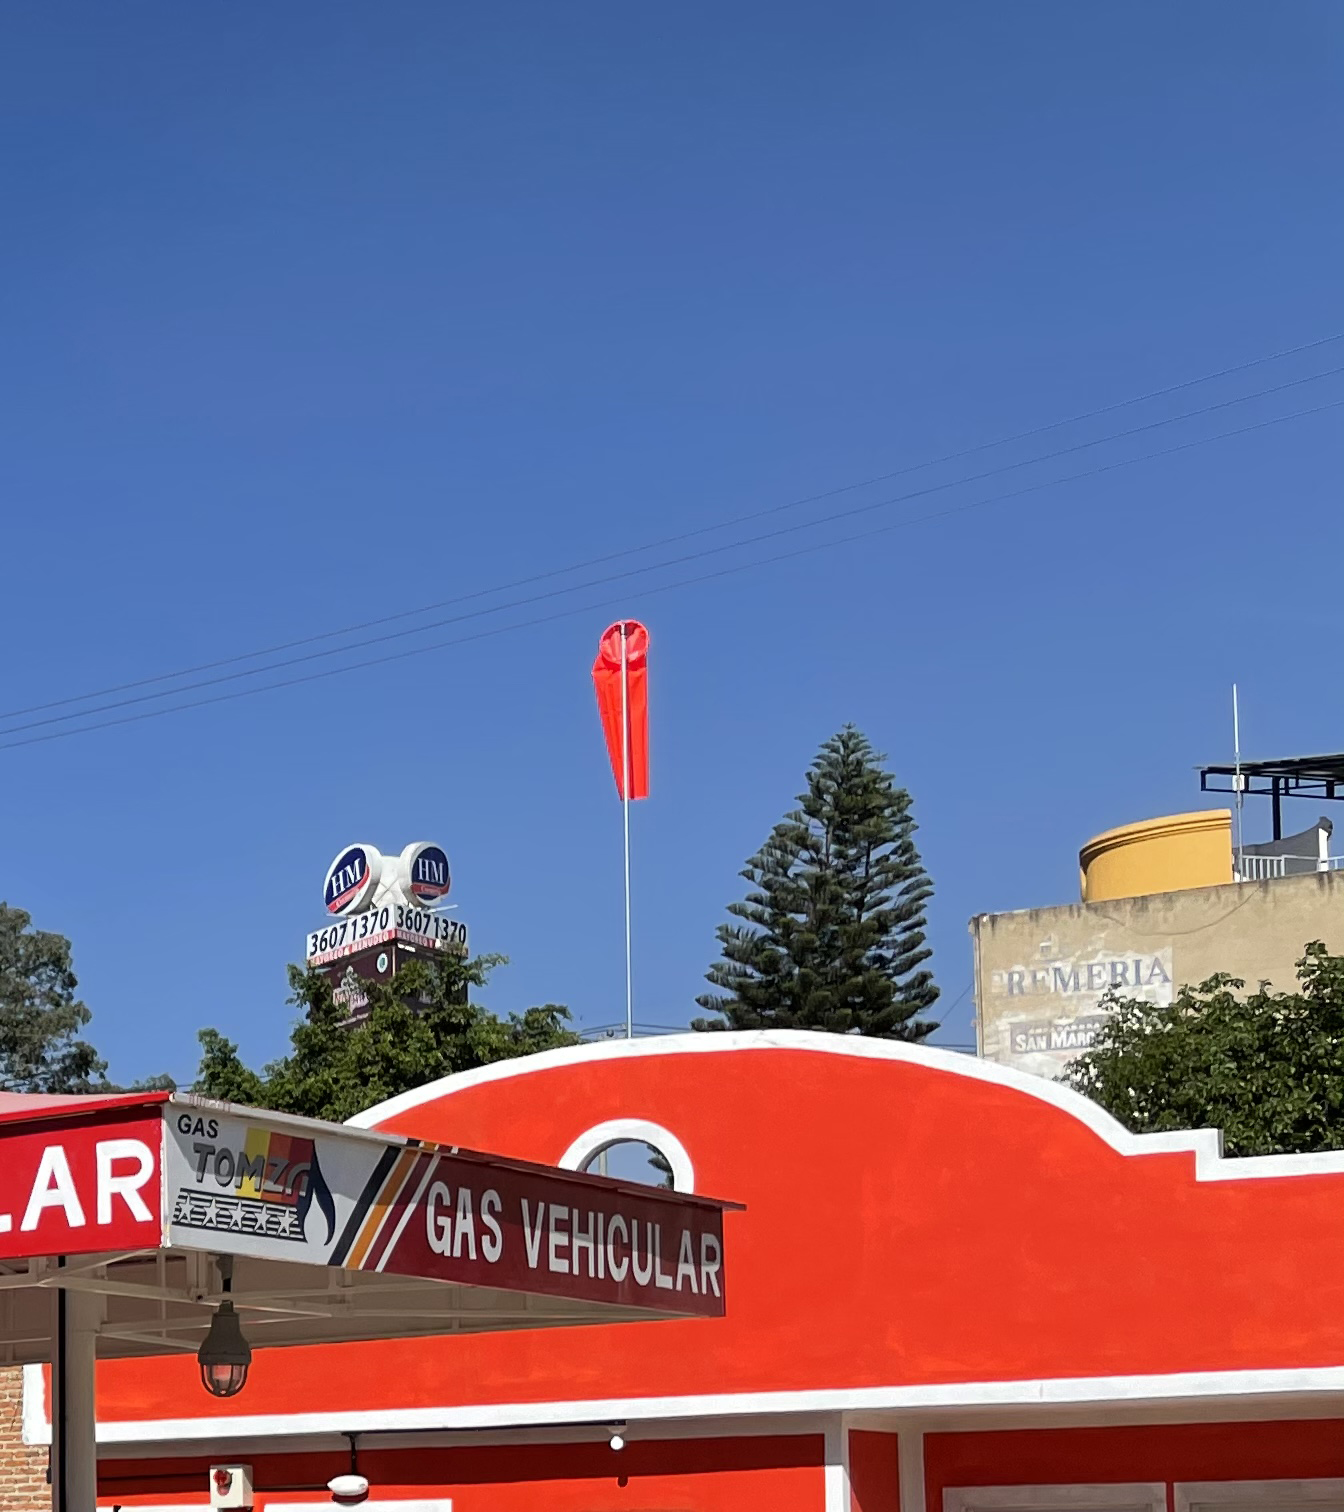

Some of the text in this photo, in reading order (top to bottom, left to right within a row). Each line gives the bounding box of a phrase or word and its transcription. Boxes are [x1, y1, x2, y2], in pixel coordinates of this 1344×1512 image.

[331, 857, 362, 897] HM
[418, 857, 444, 884] HM
[178, 1114, 219, 1139] GAS
[426, 1180, 722, 1299] GAS VEHICULAR
